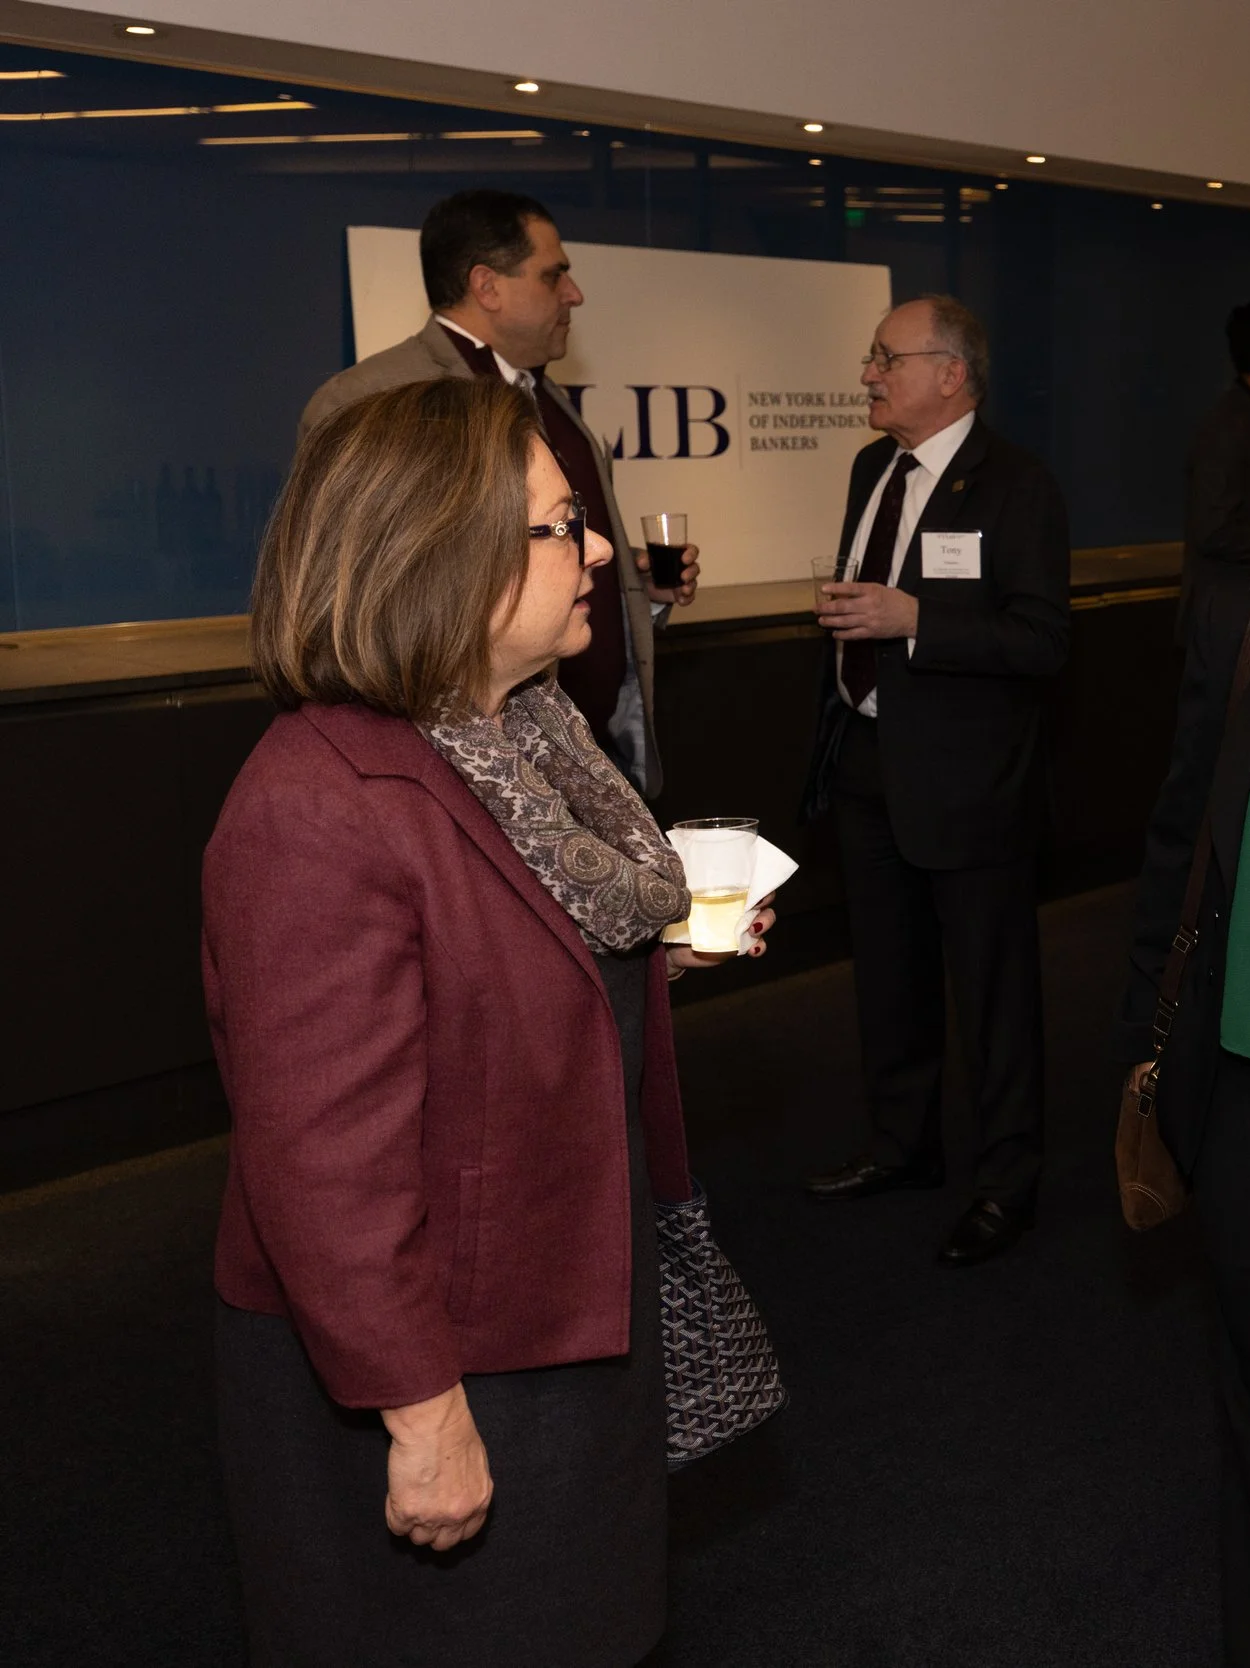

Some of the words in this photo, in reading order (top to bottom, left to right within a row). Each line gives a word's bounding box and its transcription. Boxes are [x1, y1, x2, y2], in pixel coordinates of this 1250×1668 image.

[748, 391, 782, 407] NEW
[785, 391, 825, 407] YORK
[748, 414, 769, 429] OF
[750, 435, 819, 451] BANKERS
